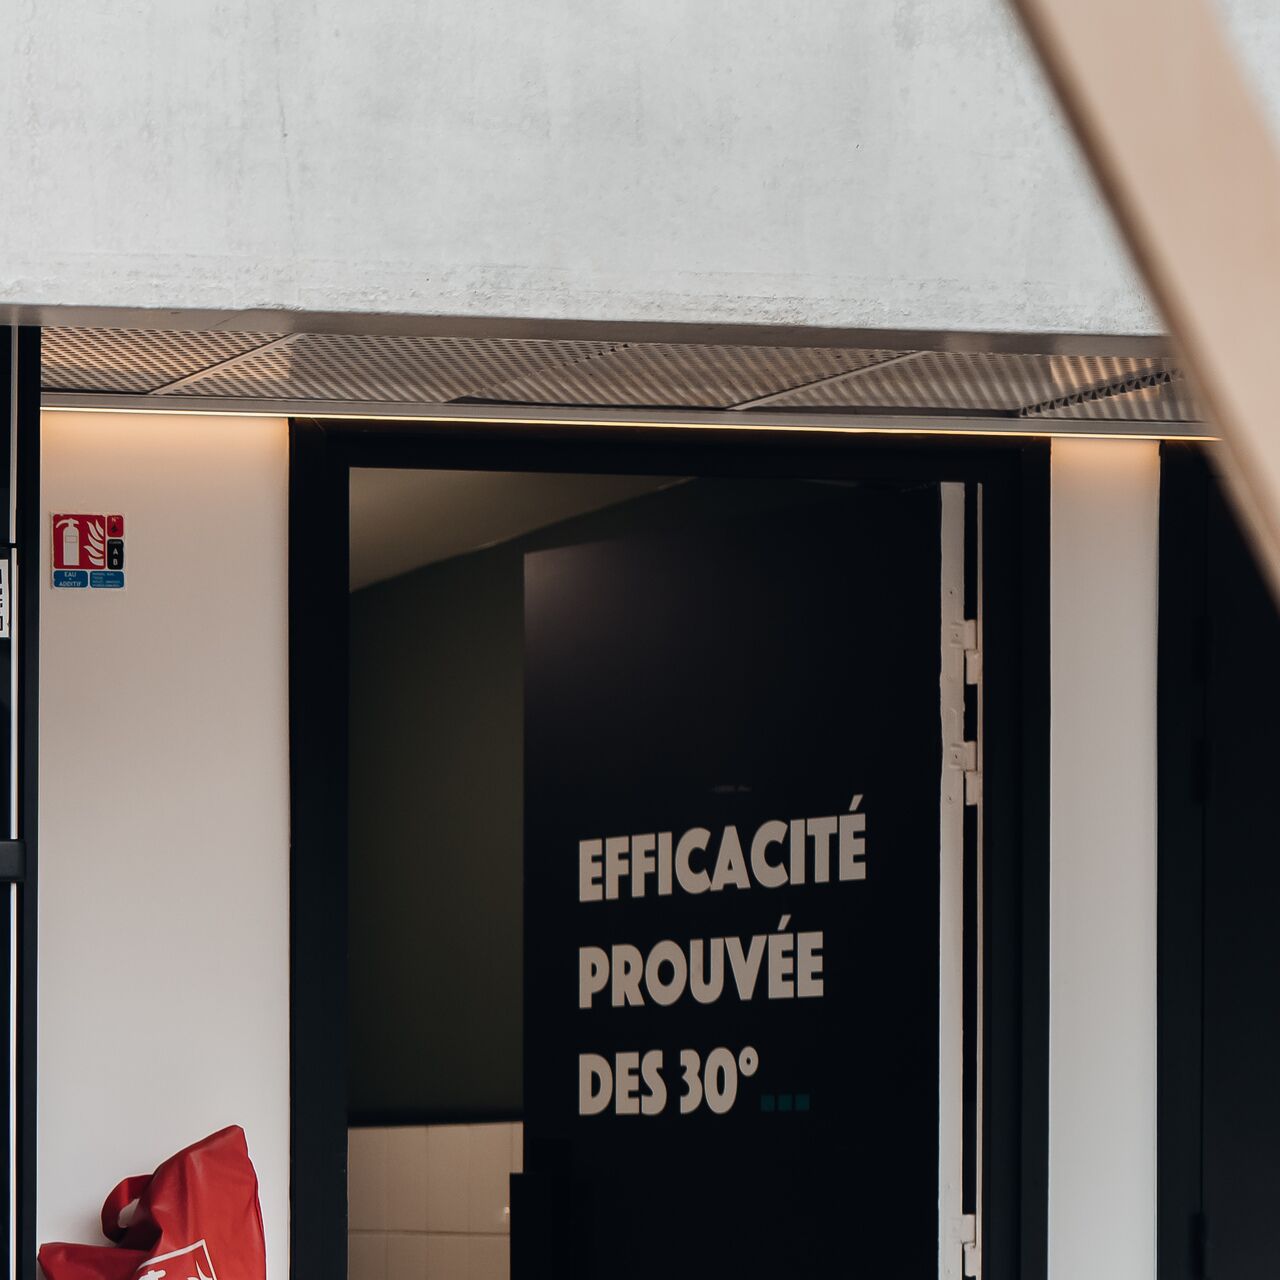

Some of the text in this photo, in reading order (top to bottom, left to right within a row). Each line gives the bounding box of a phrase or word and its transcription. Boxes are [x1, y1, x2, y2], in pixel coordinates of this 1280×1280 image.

[578, 794, 867, 902] EFFICACITÉ
[578, 914, 824, 1009] PROUVÉE
[578, 1046, 759, 1116] DES 30°
